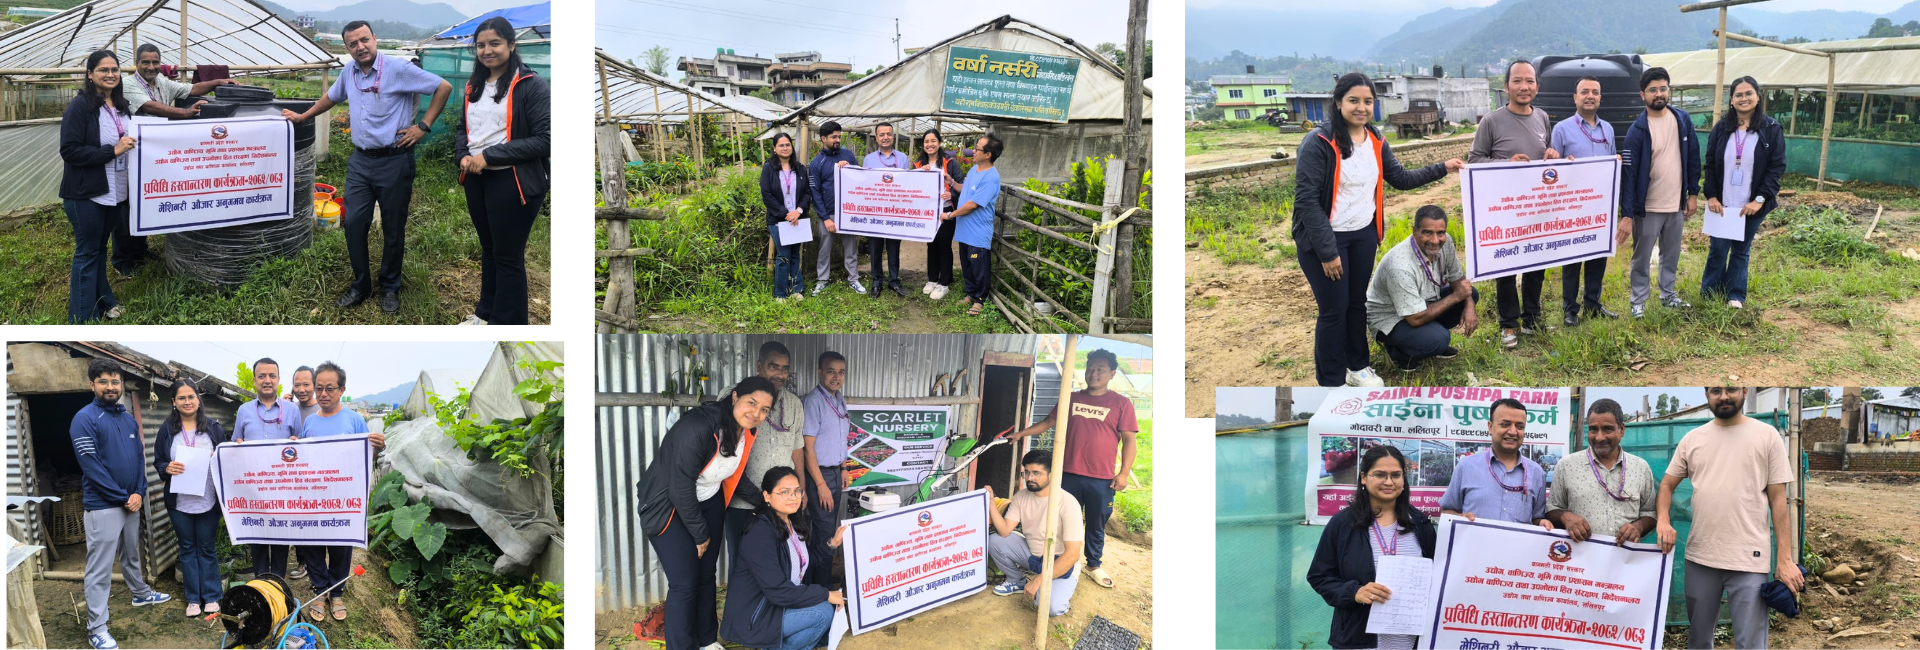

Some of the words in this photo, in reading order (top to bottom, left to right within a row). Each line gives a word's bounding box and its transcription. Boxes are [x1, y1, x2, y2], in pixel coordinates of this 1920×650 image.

[953, 54, 988, 73] वर्षा
[990, 59, 1039, 78] नर्सरी
[1366, 387, 1421, 401] SAINA
[1428, 387, 1502, 401] PUSHPA
[1510, 390, 1558, 405] FARM
[1363, 398, 1443, 421] साईना
[863, 412, 942, 423] SCARLET
[873, 424, 938, 432] NURSERY
[1350, 423, 1382, 432] गोदावरी
